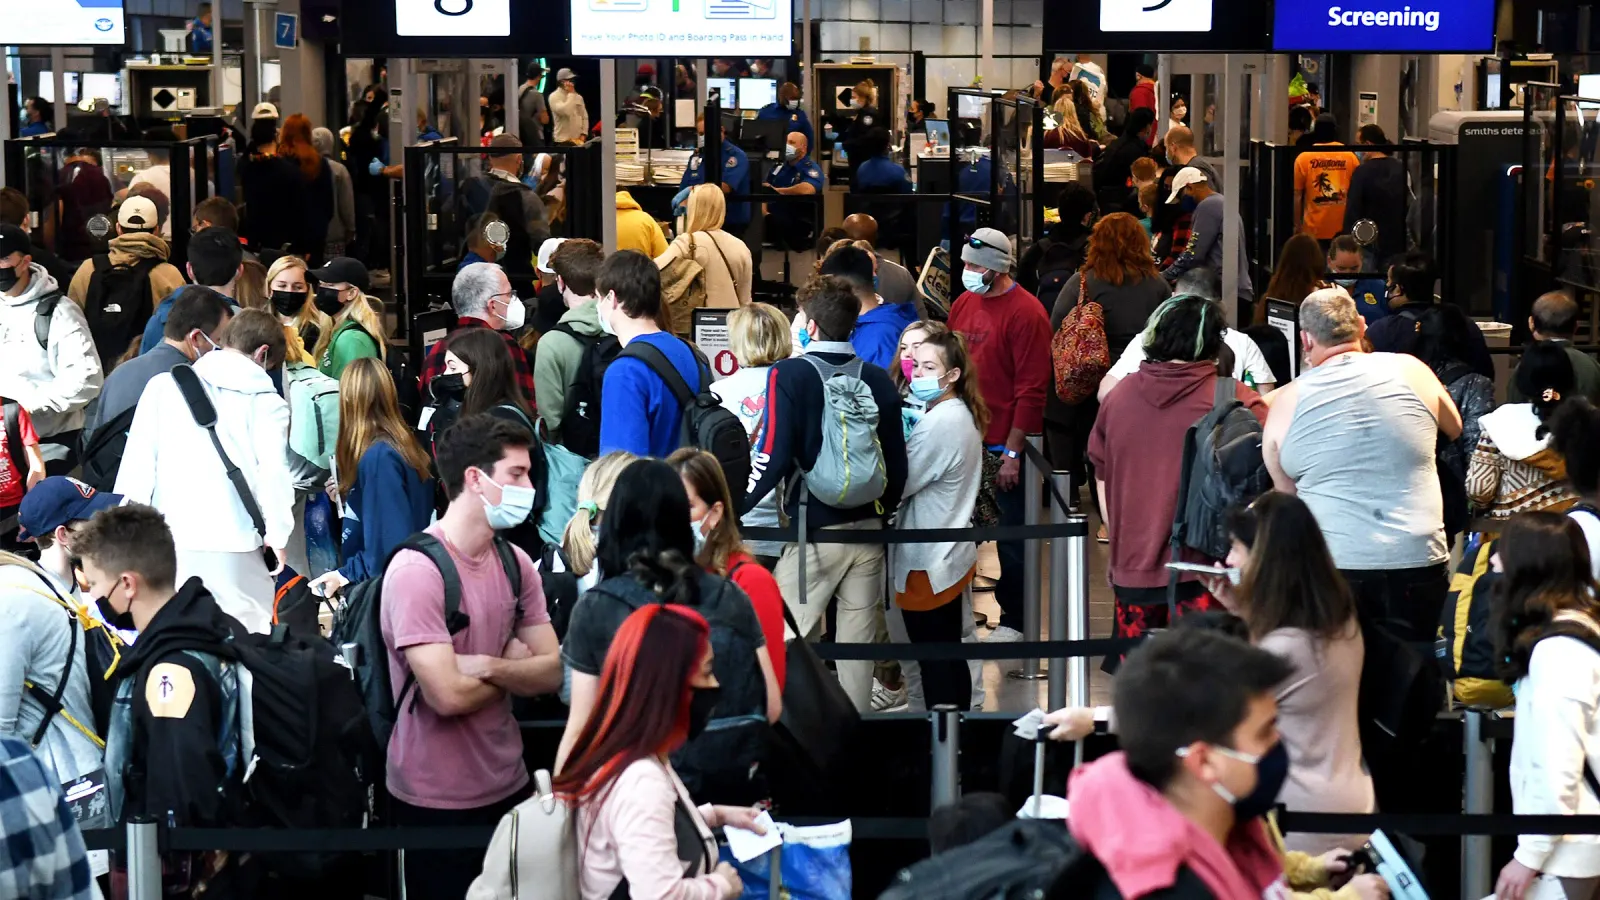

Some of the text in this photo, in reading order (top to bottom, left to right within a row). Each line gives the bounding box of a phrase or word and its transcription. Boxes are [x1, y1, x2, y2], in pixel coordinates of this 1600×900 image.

[1328, 6, 1440, 31] Screening
[280, 22, 290, 38] 7
[606, 32, 625, 41] Your
[628, 32, 654, 41] Photo
[657, 32, 666, 41] ID
[669, 33, 685, 41] and
[687, 33, 727, 43] Boarding
[729, 33, 747, 41] Pass
[760, 33, 784, 41] Hand
[1465, 127, 1499, 136] smiths
